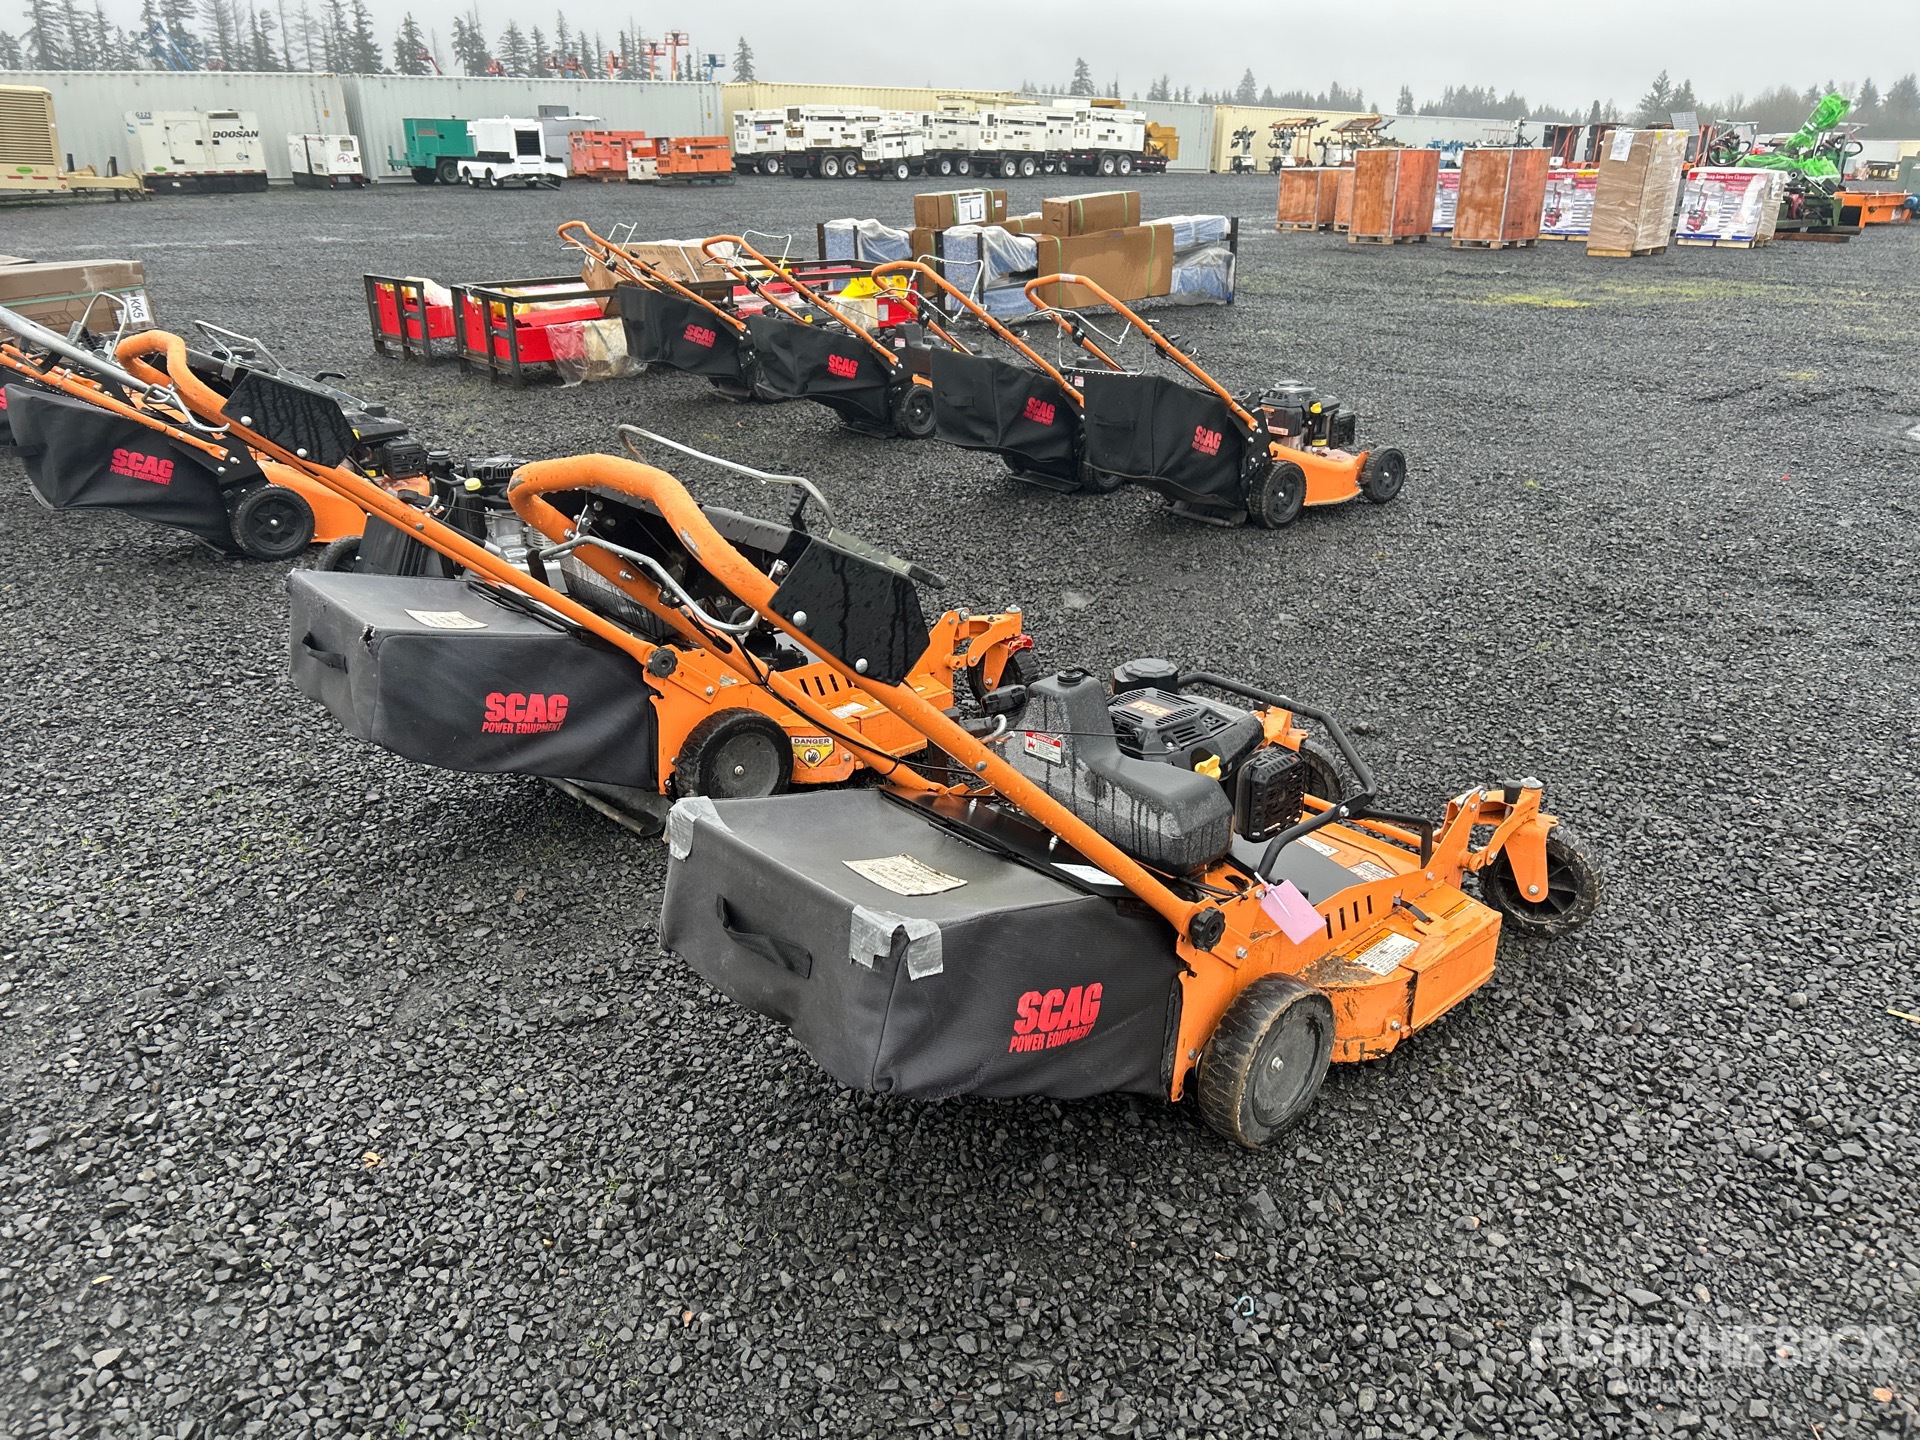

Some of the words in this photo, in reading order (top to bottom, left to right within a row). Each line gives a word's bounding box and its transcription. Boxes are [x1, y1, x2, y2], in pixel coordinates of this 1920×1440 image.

[212, 130, 259, 138] DOOSAN
[130, 297, 144, 319] KK5
[685, 324, 716, 343] SCAG
[828, 354, 859, 374] SCAG
[1026, 397, 1056, 420] SCAG
[1194, 425, 1223, 450] SCAG
[111, 448, 175, 478] SCAG
[109, 464, 134, 478] POWER
[133, 470, 172, 486] EQUIPMENT
[484, 692, 569, 723] SCAG
[481, 721, 514, 734] POWER
[515, 720, 564, 734] EQUIPMENT
[1013, 982, 1103, 1035] SCAG
[1008, 1033, 1046, 1054] POWER
[1045, 1022, 1096, 1049] EQUIPMENT
